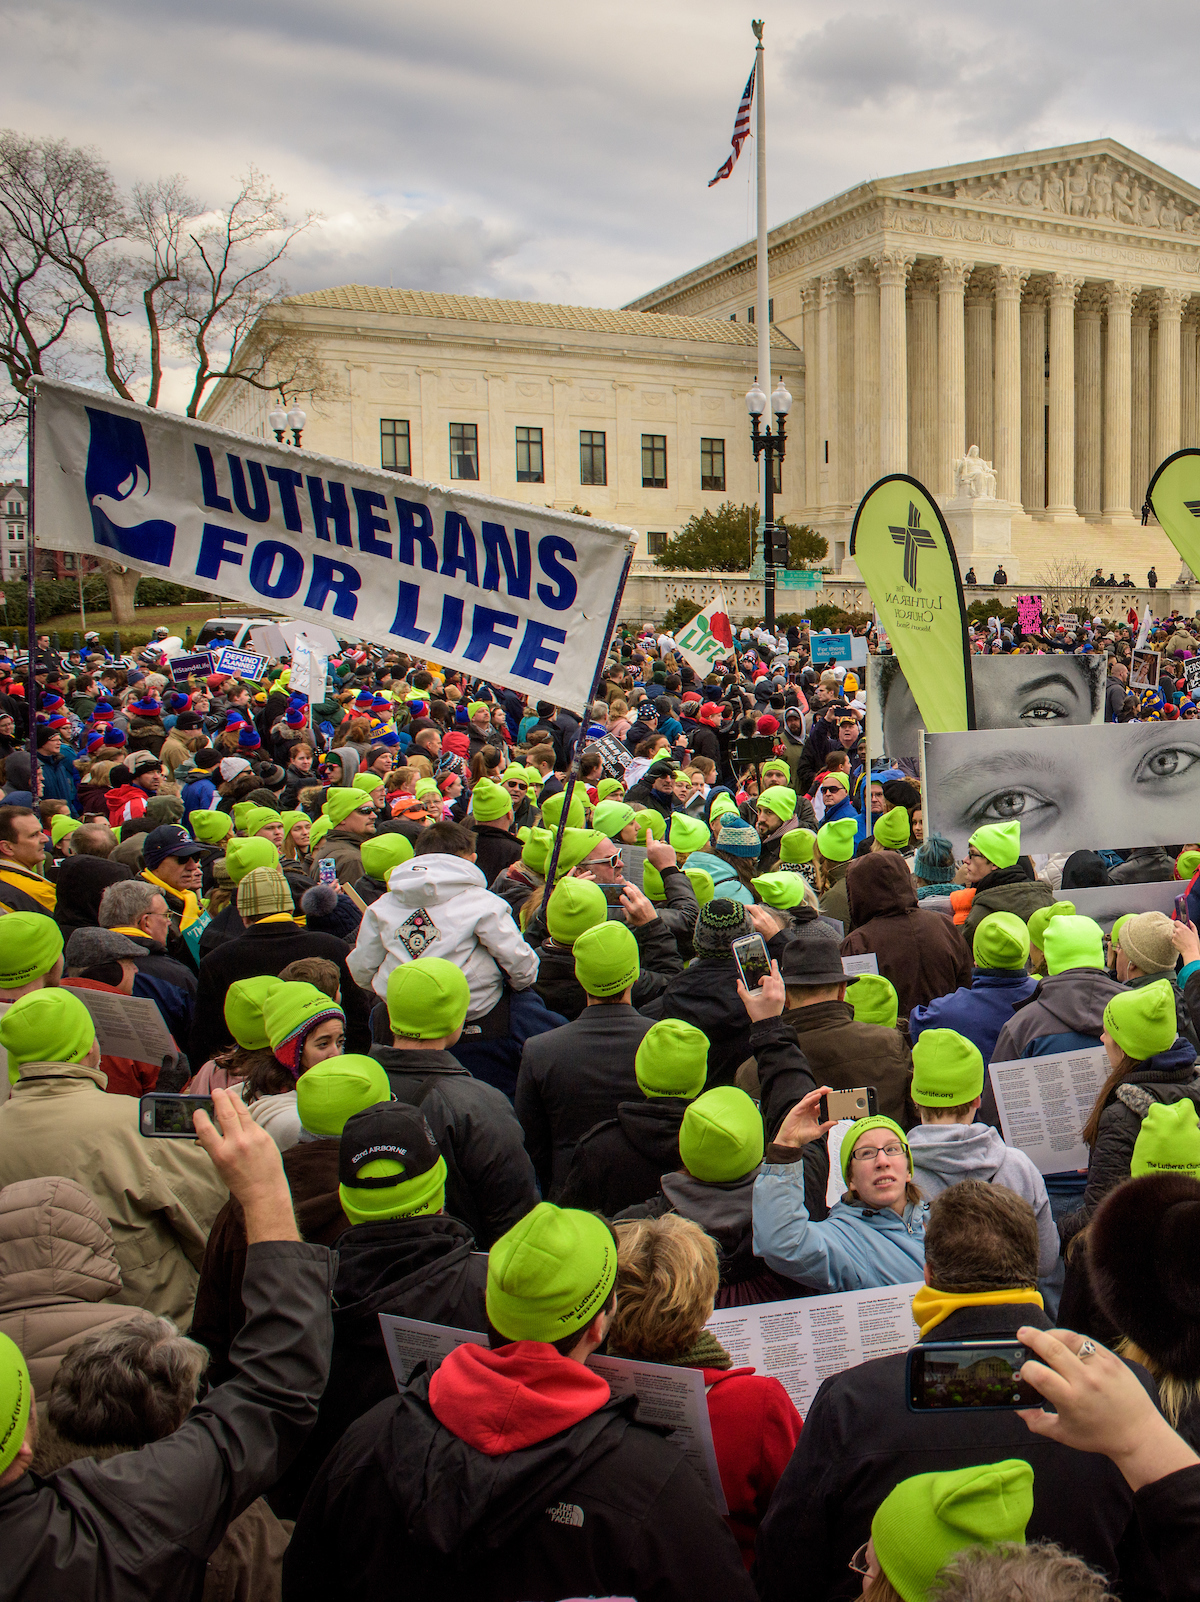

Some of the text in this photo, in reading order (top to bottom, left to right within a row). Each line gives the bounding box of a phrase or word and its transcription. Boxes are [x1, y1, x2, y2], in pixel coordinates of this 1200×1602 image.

[194, 443, 578, 612] LUTHERANS
[194, 522, 568, 686] FOR LIFE
[678, 628, 726, 663] LIFE
[222, 658, 256, 670] PLANNED
[225, 652, 258, 664] DEFUND
[18, 965, 38, 975] Church
[602, 975, 623, 988] Lutheran
[624, 966, 637, 979] Church
[351, 1145, 407, 1164] 82nd AIRBORNE
[1158, 1162, 1186, 1170] Lutheran
[558, 1310, 574, 1322] The
[574, 1279, 602, 1312] Lutheran
[576, 1292, 602, 1320] MISSOURI
[545, 1506, 573, 1518] NORTH
[558, 1502, 574, 1512] THE
[551, 1514, 570, 1524] FACE
